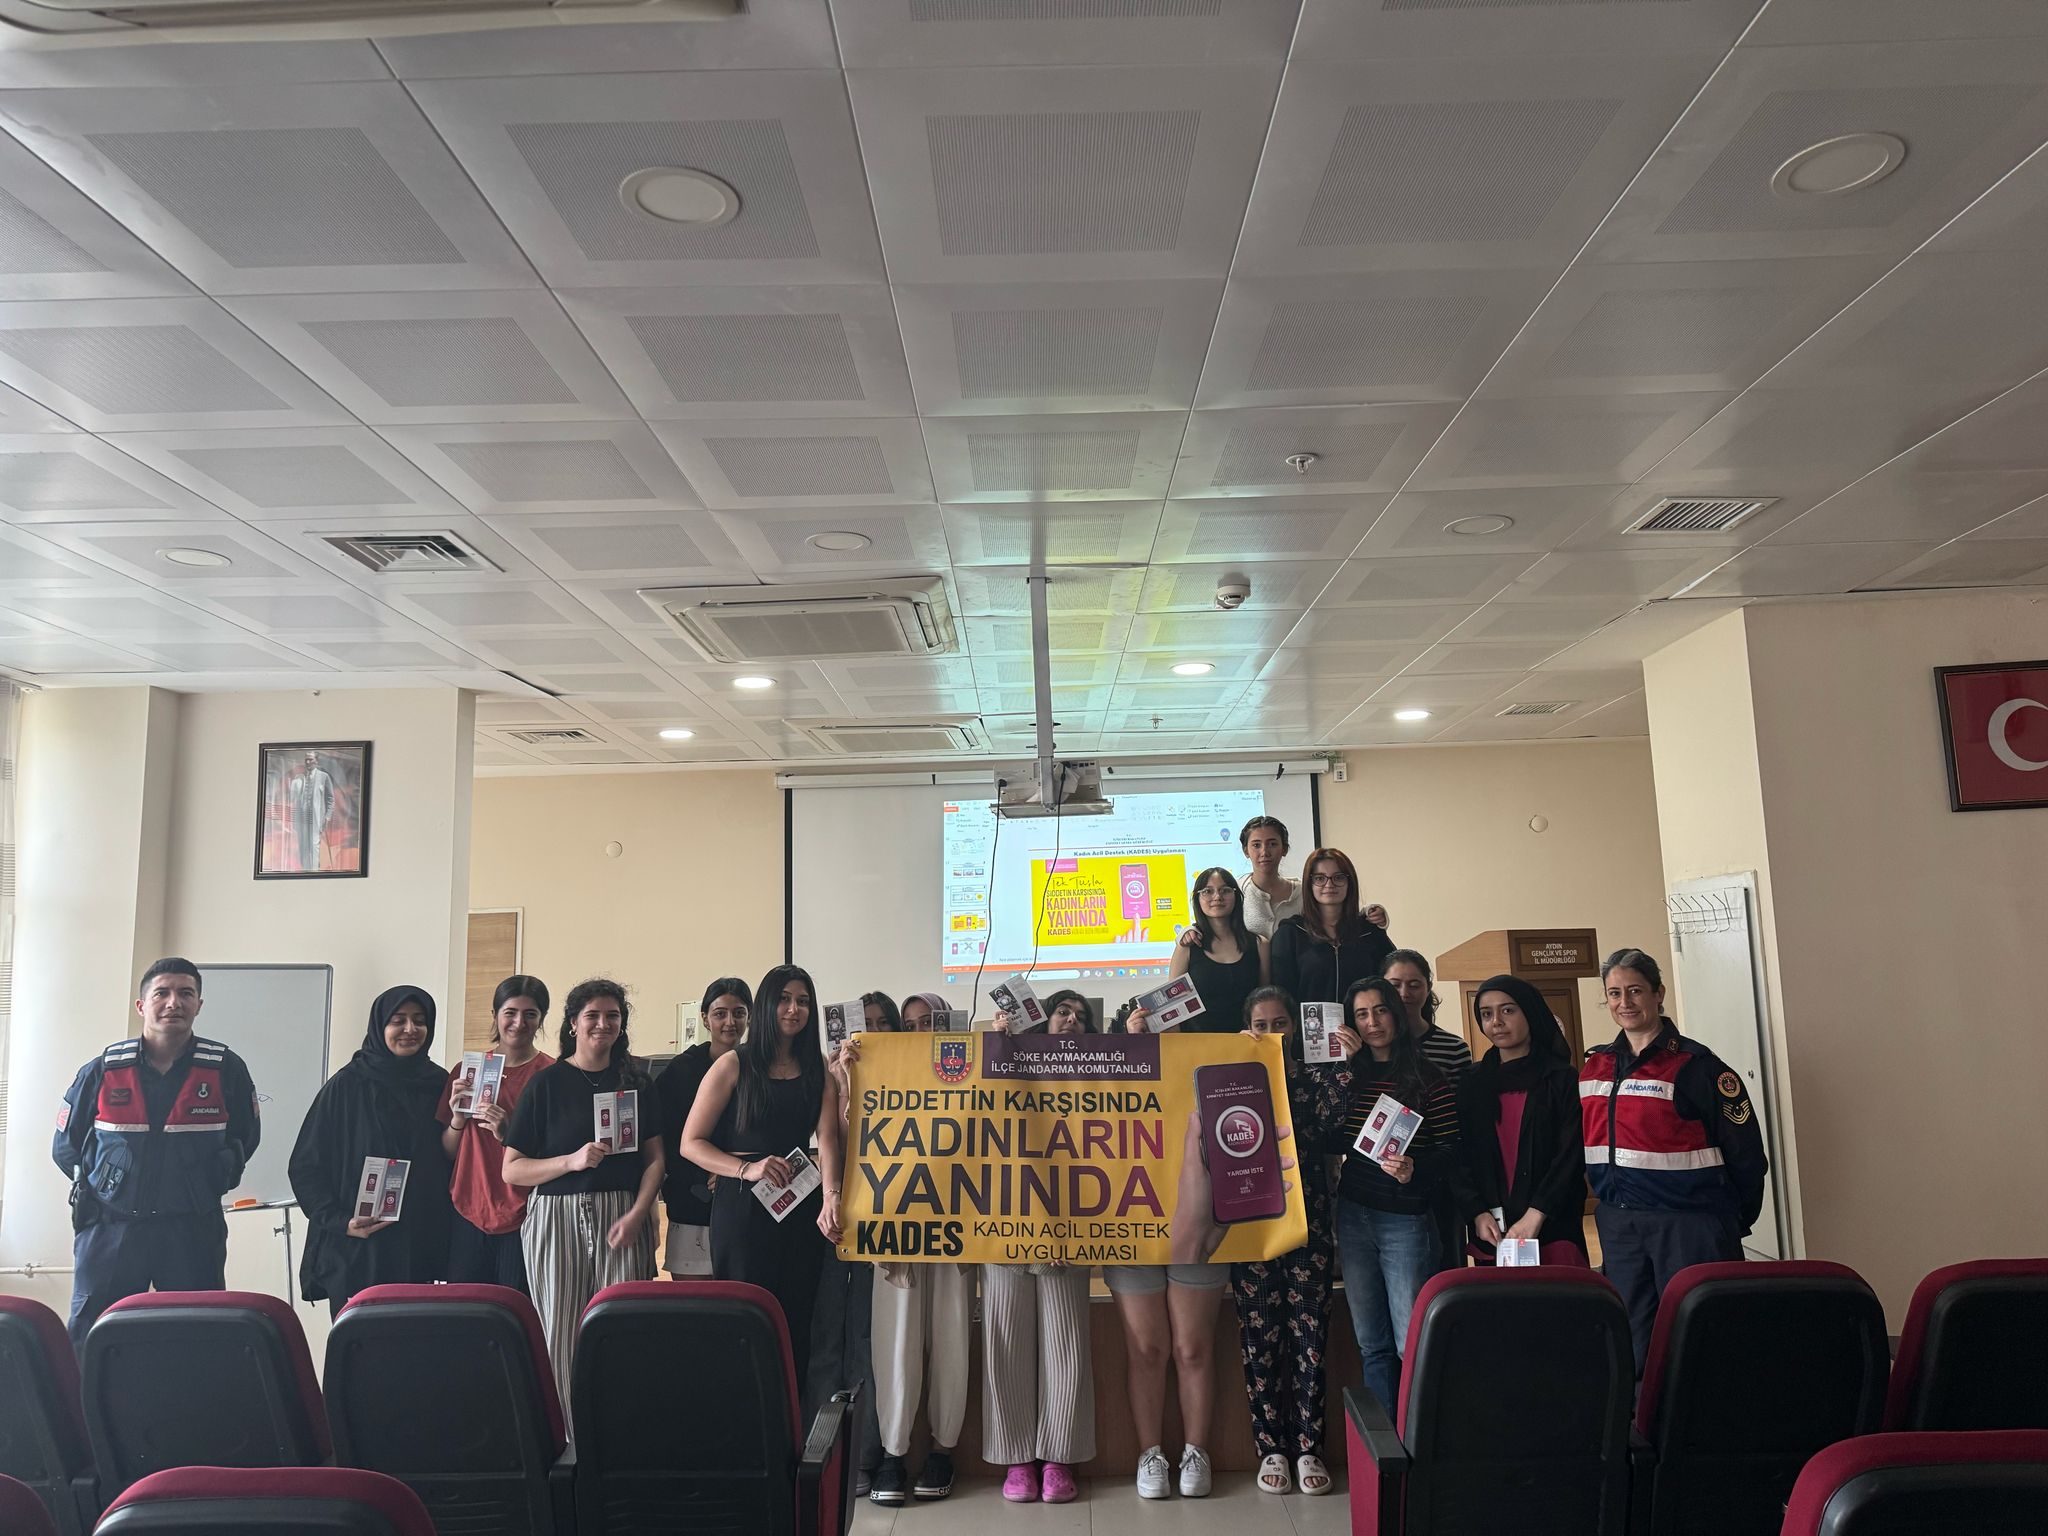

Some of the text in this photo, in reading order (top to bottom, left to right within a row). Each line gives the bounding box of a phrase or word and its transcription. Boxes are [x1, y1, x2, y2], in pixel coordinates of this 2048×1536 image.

[1047, 896, 1107, 910] KADINLARIN
[1048, 910, 1107, 928] YANINDA
[1531, 949, 1555, 957] GENÇLİK
[1534, 956, 1576, 965] İL MÜDÜRLÜĞÜ
[1059, 1040, 1078, 1050] T.C.
[1013, 1051, 1125, 1063] SÖKE KAYMAKAMLIĞI
[991, 1060, 1152, 1074] İLÇE JANDARMA KOMUTANLIĞI
[1625, 1083, 1664, 1093] JANDARMA
[862, 1084, 1163, 1118] ŞİDDETTİN KARŞISINDA
[859, 1117, 1165, 1159] KADINLARIN
[1227, 1131, 1255, 1142] KADES
[1227, 1168, 1250, 1177] YARDIM
[859, 1163, 1166, 1218] YANINDA
[974, 1219, 1170, 1239] KADIN ACİL DESTEK
[857, 1220, 964, 1257] KADES
[1005, 1243, 1138, 1261] UYGULAMASI
